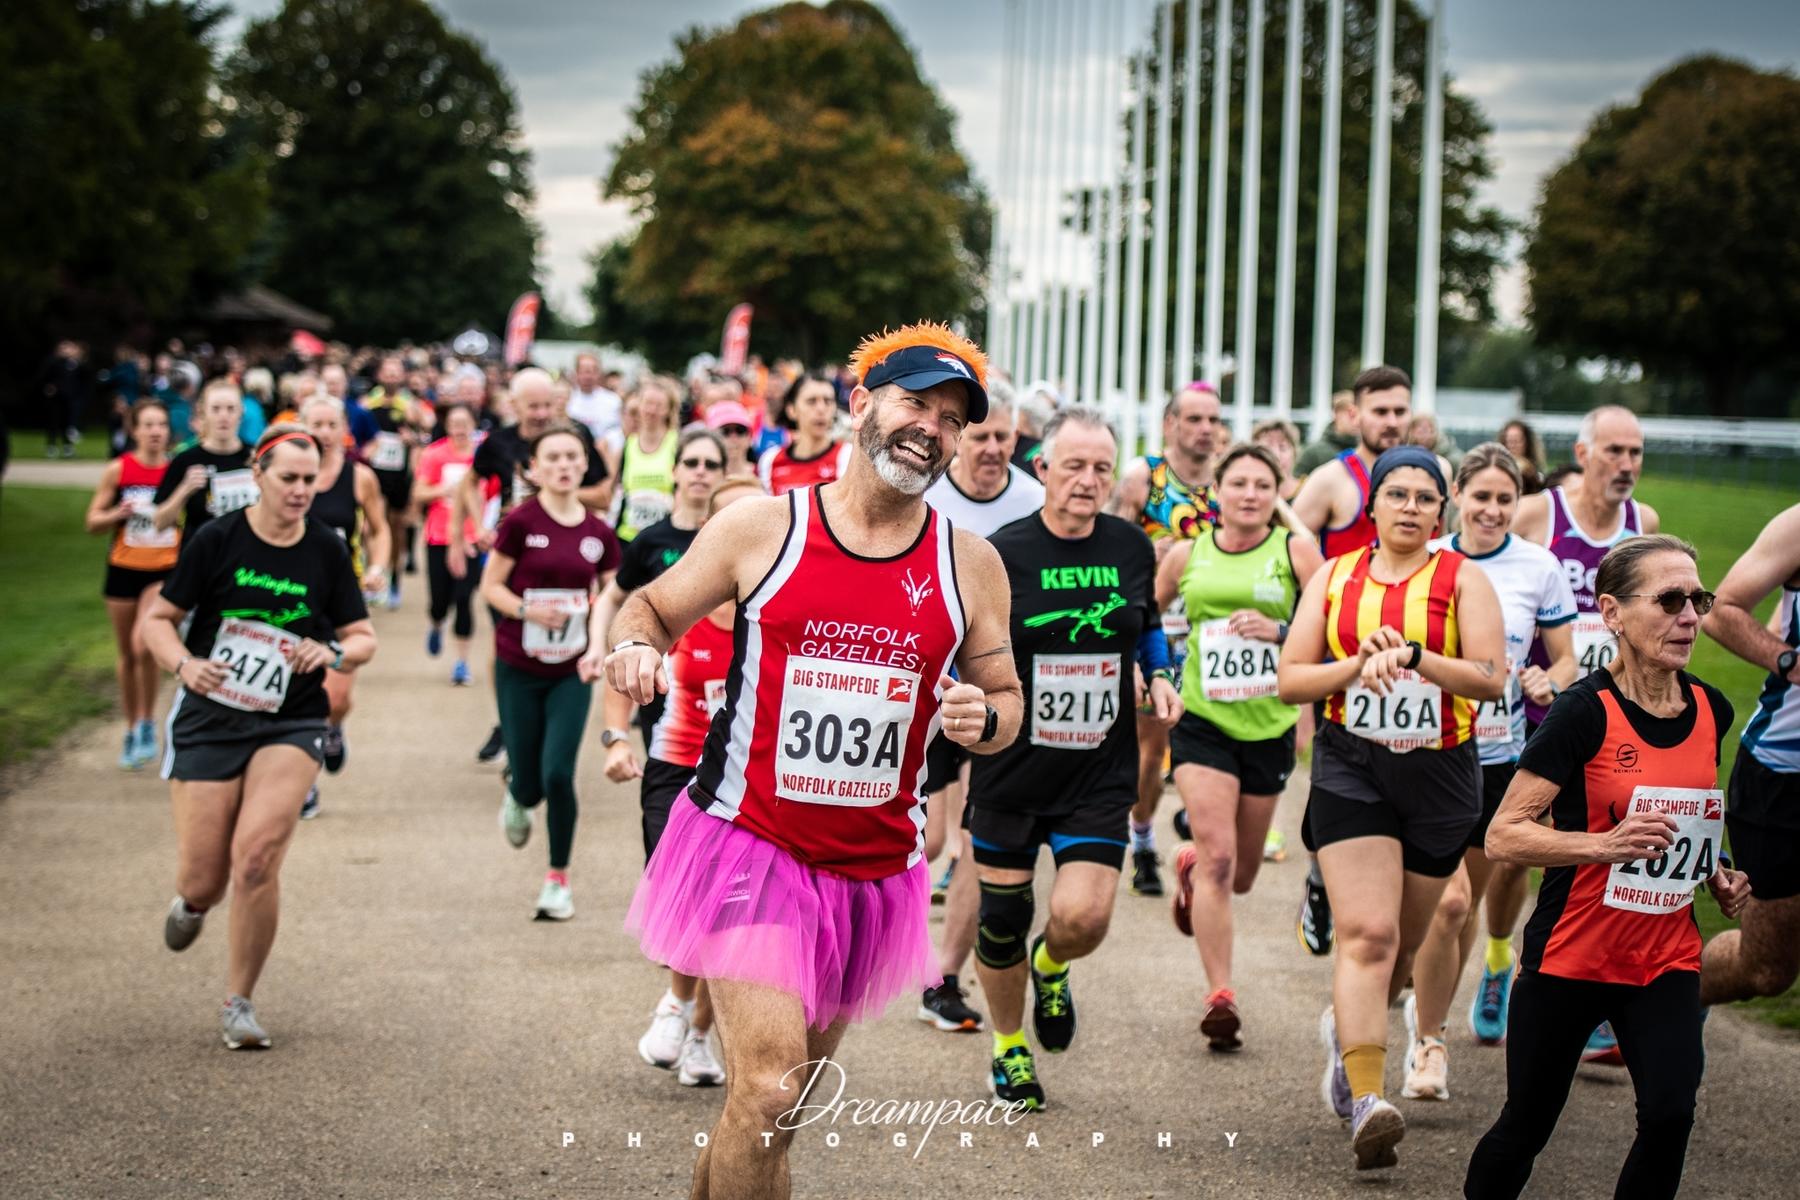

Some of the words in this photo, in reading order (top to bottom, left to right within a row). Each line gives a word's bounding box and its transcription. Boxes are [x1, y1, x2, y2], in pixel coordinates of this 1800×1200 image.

[1041, 566, 1120, 590] KEVIN
[804, 620, 921, 650] NORFOLK
[801, 640, 920, 671] GAZELLES
[1207, 648, 1277, 679] 268A
[792, 669, 813, 687] BIG
[816, 671, 880, 695] STAMPEDE
[1055, 663, 1096, 677] STAMPEDE
[1039, 690, 1116, 723] 321A
[1353, 695, 1438, 729] 216A
[784, 710, 899, 768] 303A
[1039, 728, 1075, 743] NORFOLK
[782, 773, 836, 796] NORFOLK
[838, 780, 892, 798] GAZELLES
[1635, 799, 1652, 814] BIG
[1654, 799, 1700, 816] STAMPEDE
[1613, 885, 1662, 907] NORFOLK
